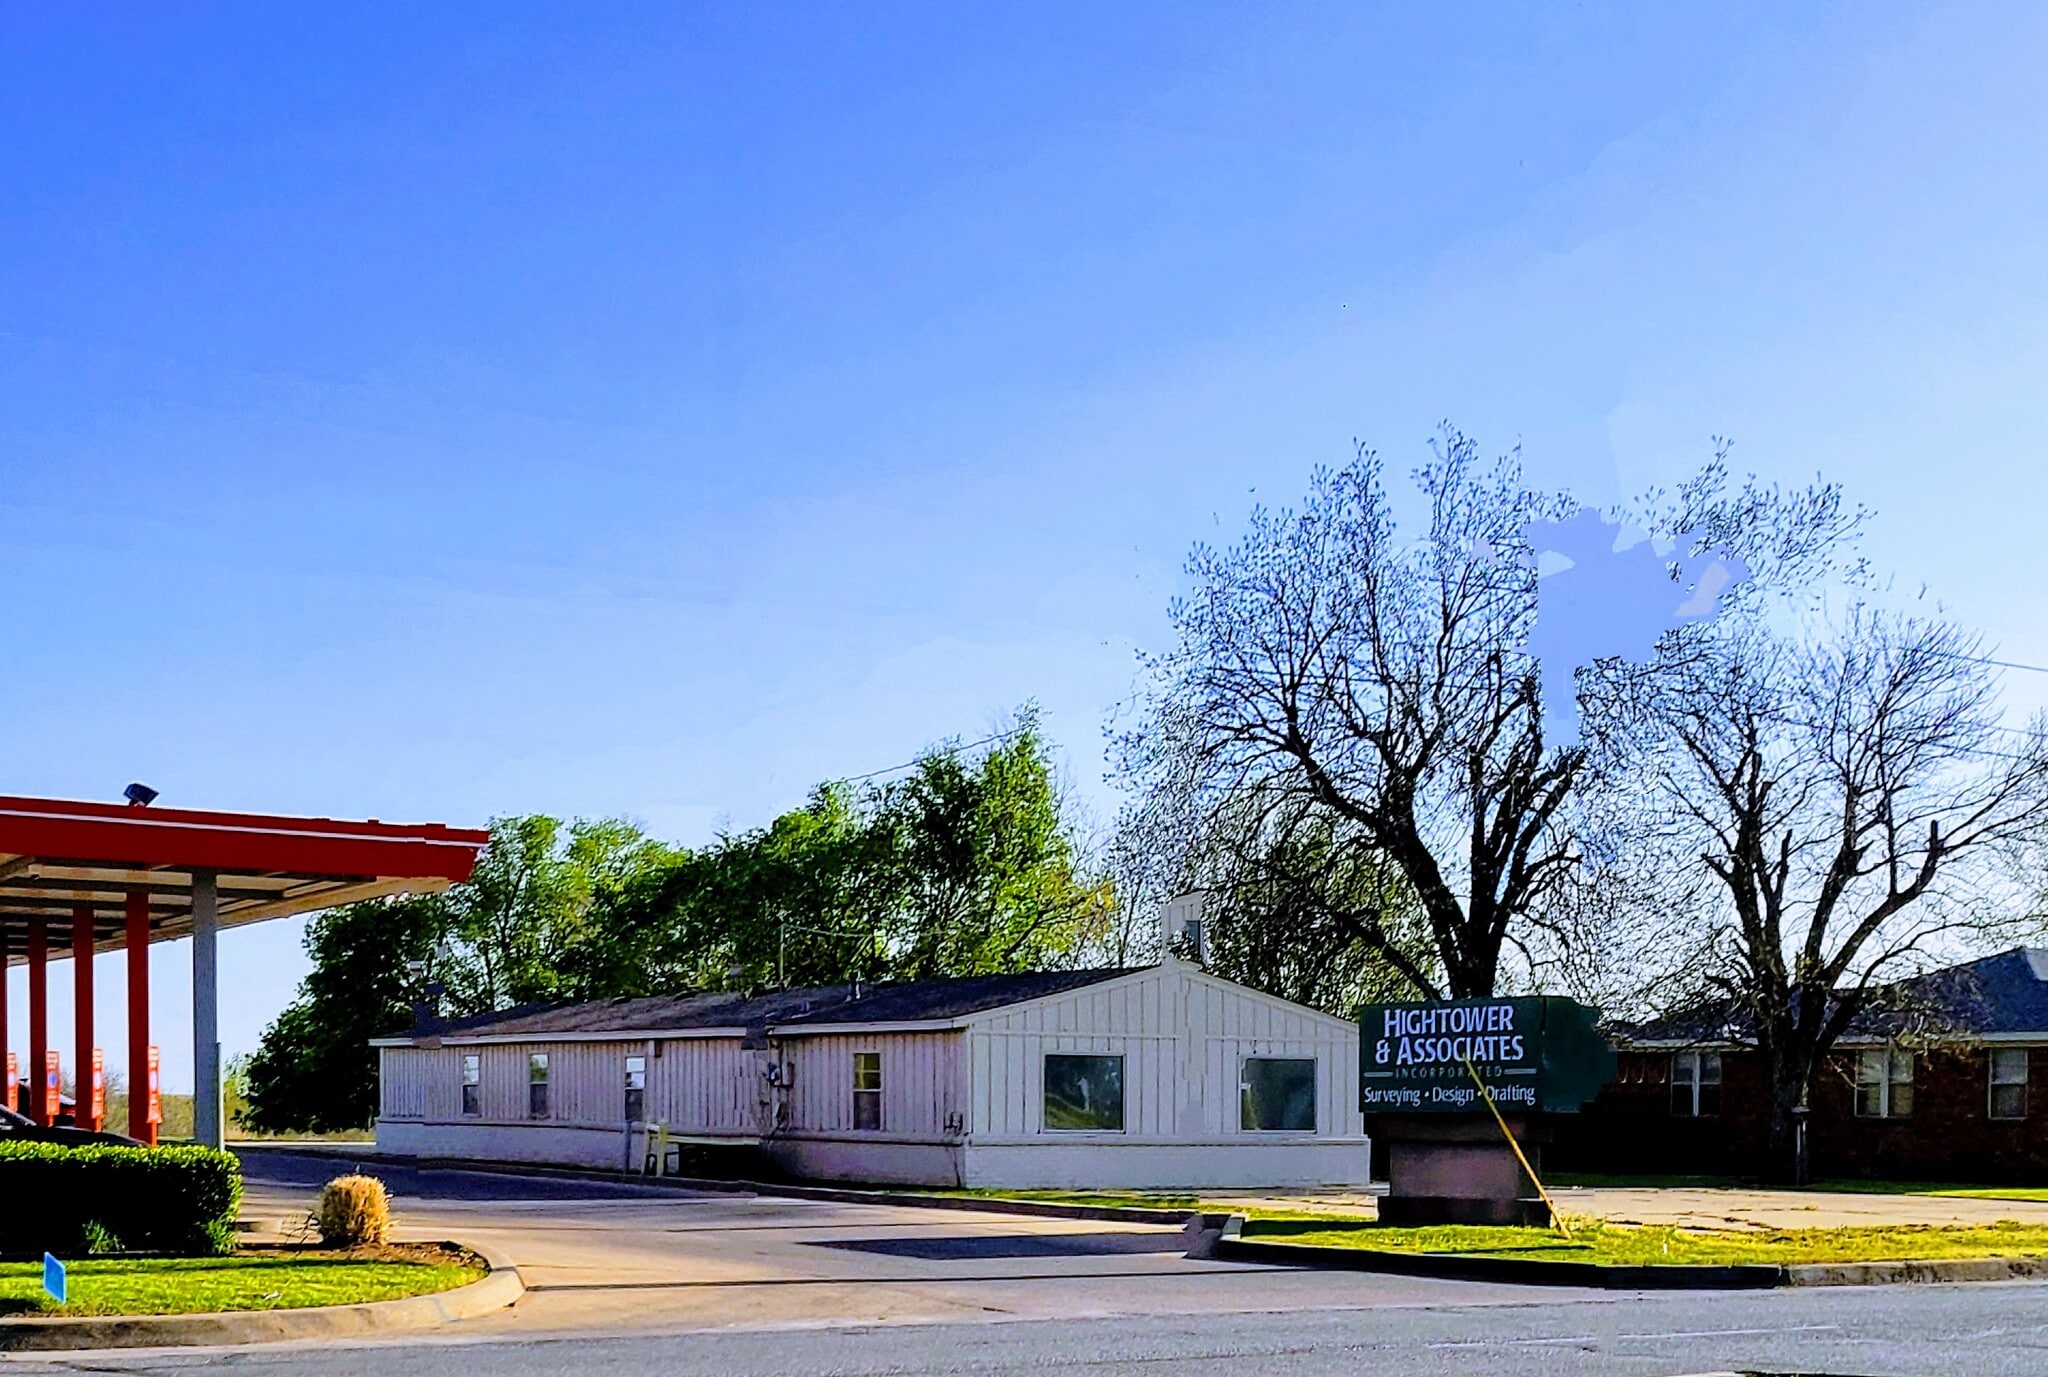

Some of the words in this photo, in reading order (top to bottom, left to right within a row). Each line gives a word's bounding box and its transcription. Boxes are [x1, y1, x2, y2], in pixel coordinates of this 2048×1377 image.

[1383, 1005, 1514, 1038] HIGHTOWER
[1375, 1039, 1391, 1064] &
[1395, 1035, 1525, 1065] ASSOCIATES
[1364, 1086, 1421, 1107] Surveying
[1432, 1085, 1474, 1106] Design
[1485, 1084, 1536, 1106] Drafting
